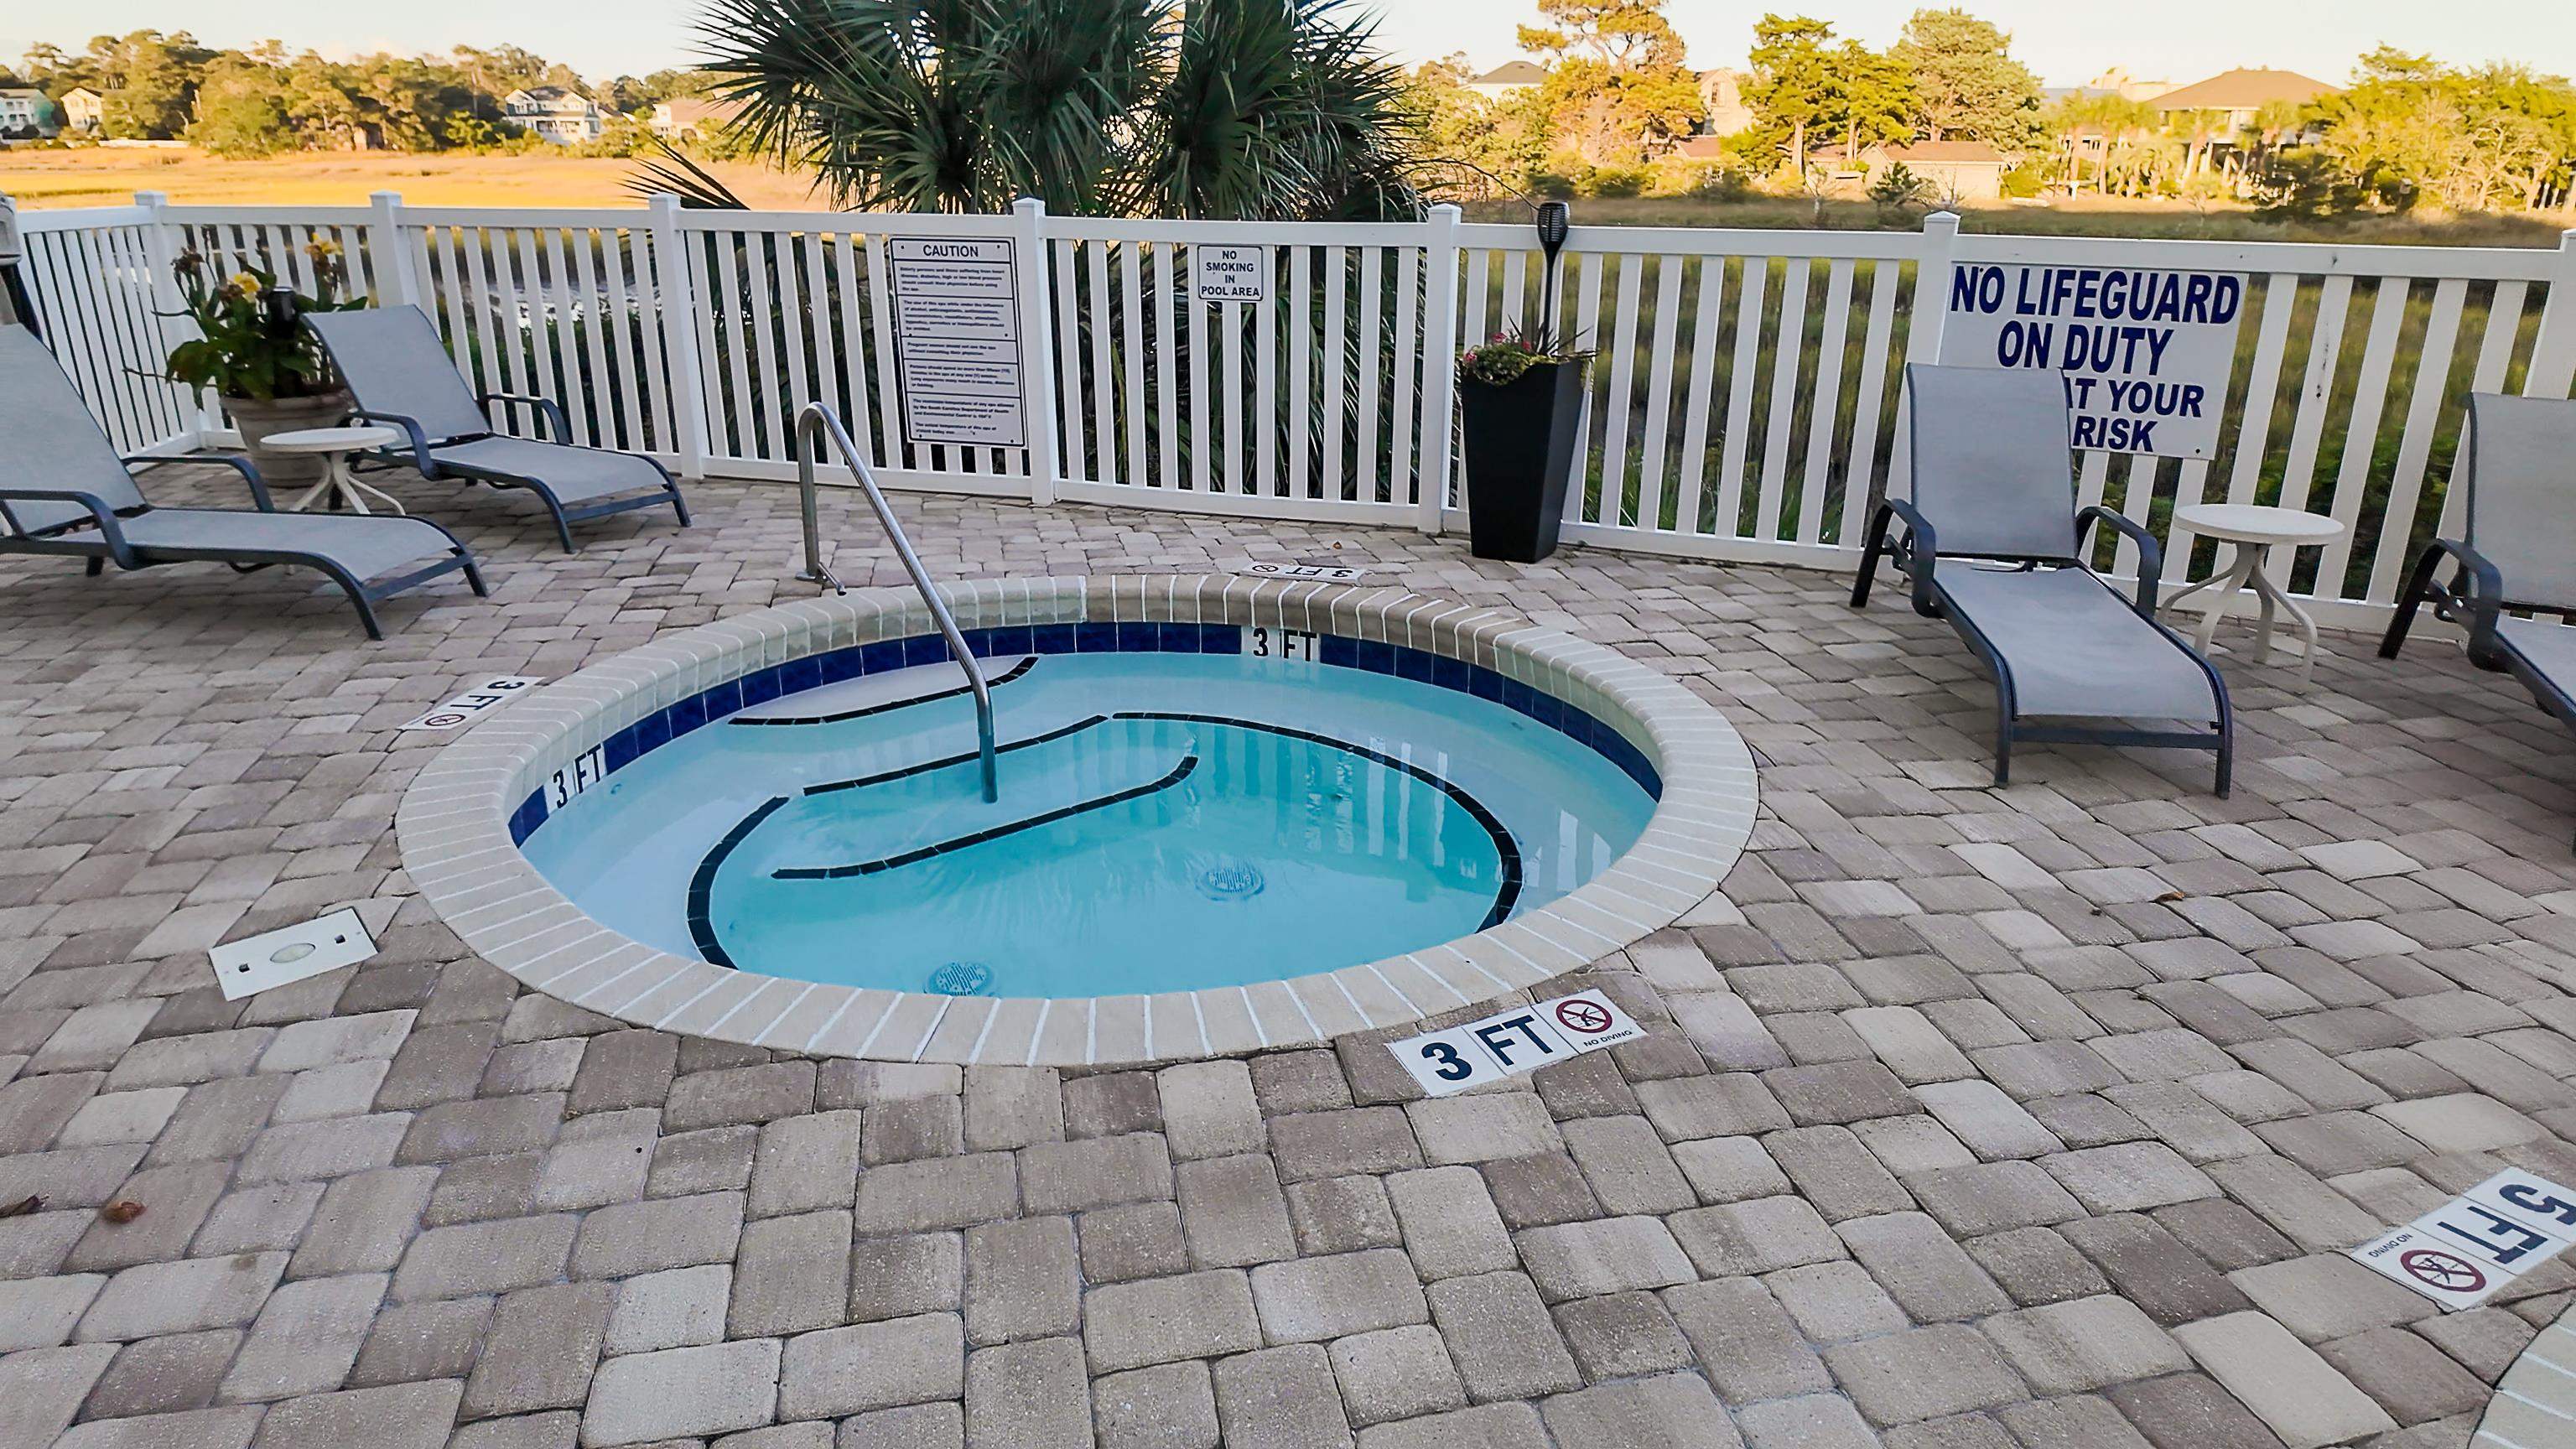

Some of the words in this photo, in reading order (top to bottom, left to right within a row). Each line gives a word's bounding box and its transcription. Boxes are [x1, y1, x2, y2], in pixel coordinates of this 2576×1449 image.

[923, 244, 979, 257] CAUTION
[1222, 250, 1237, 259] NO
[1206, 262, 1254, 272] SMOKING
[1225, 275, 1235, 283] IN
[1201, 286, 1228, 295] POOL
[1232, 287, 1259, 296] AREA
[1950, 265, 2005, 314] NO
[2015, 267, 2241, 325] LIFEGUARD
[1997, 319, 2054, 369] ON
[2063, 324, 2174, 376] DUTY
[2108, 379, 2205, 418] YOUR
[2072, 415, 2158, 453] RISK
[1285, 567, 1323, 576] FT
[1332, 569, 1353, 578] 3
[1253, 627, 1269, 657] 3
[1283, 629, 1318, 662] FT
[487, 680, 525, 690] 3
[450, 694, 503, 710] FT
[553, 769, 568, 808] 3
[574, 743, 601, 794] FT
[1583, 1038, 1600, 1047] NO
[1601, 1029, 1633, 1042] DIVING
[1421, 1041, 1472, 1081] 3
[1474, 1015, 1555, 1067] FT
[2499, 1184, 2576, 1225] 5
[2397, 1233, 2413, 1244] NO
[2437, 1206, 2549, 1265] FT
[2368, 1239, 2399, 1258] DIVING
